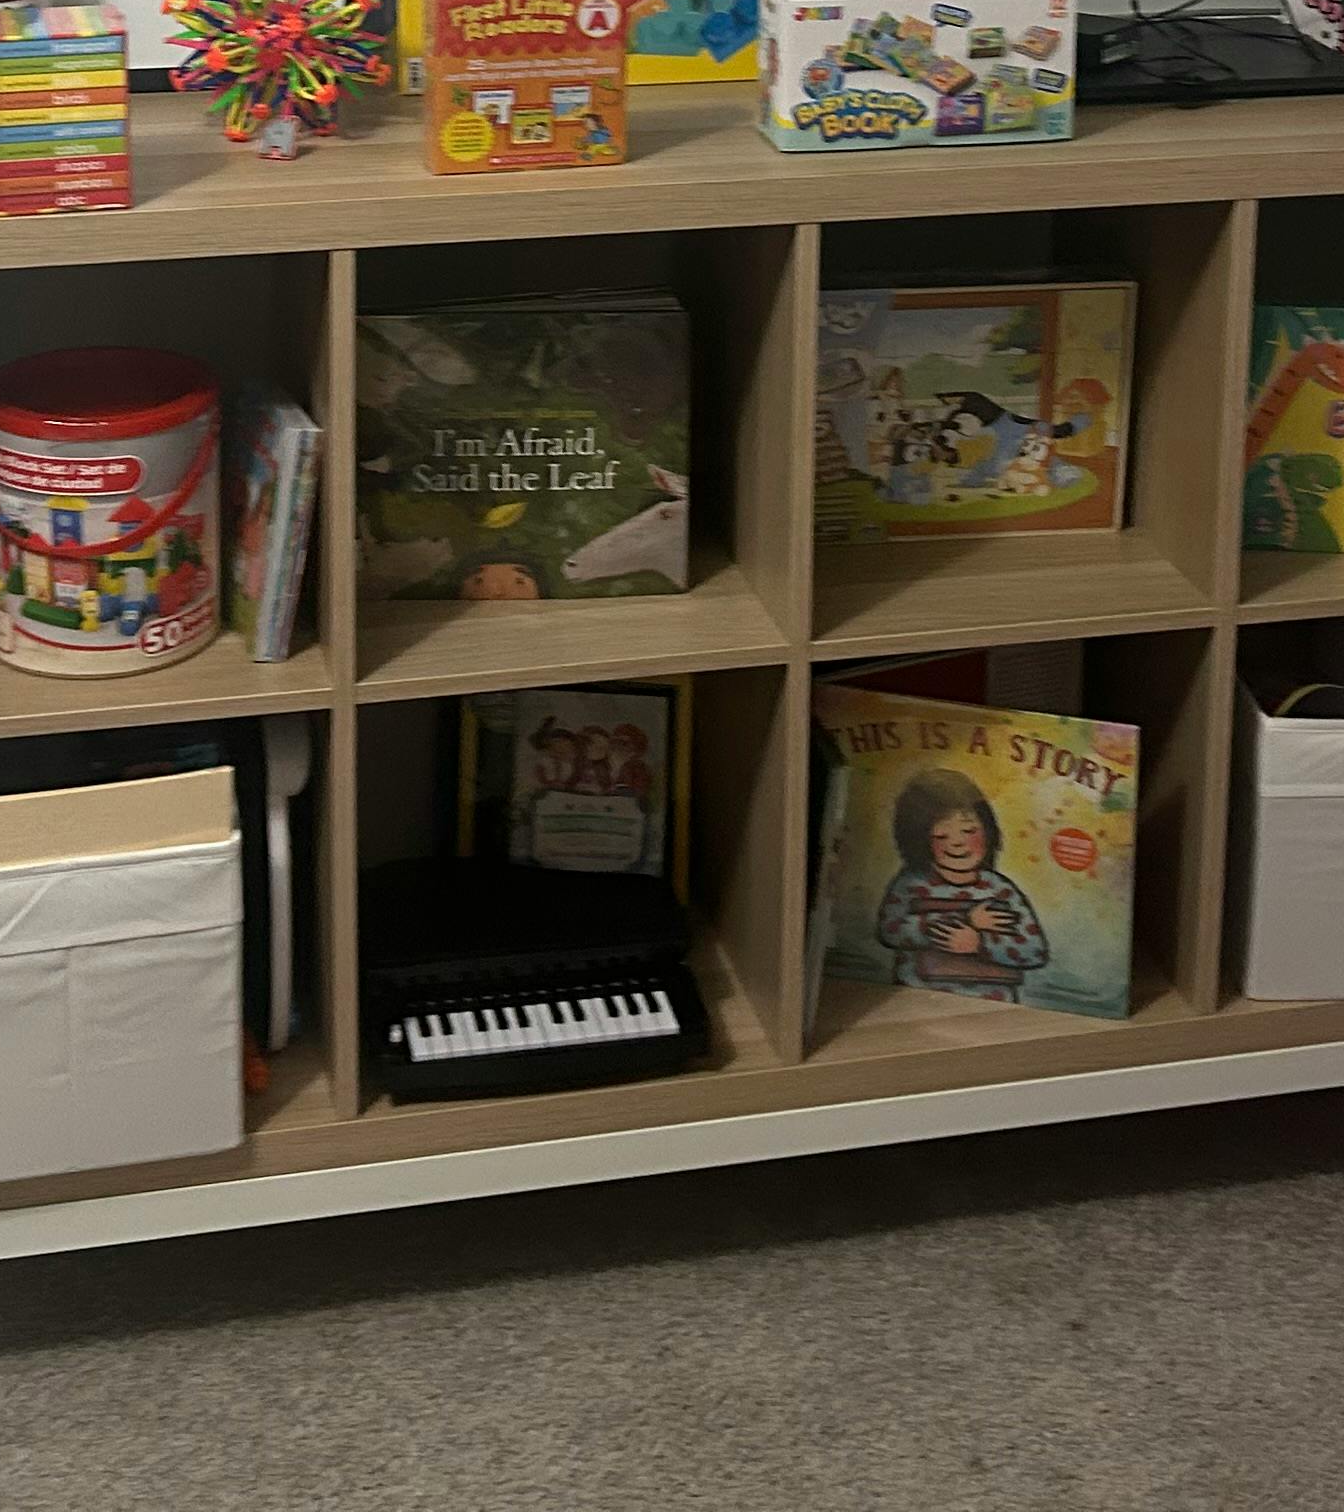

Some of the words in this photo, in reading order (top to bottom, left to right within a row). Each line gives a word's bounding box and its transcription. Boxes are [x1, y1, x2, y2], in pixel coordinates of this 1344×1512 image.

[463, 18, 568, 42] Readers
[588, 10, 610, 31] A
[822, 111, 898, 138] BOOK
[431, 427, 487, 457] I'm
[411, 462, 480, 493] Said
[488, 463, 541, 492] the
[546, 459, 621, 492] Leaf
[144, 619, 185, 655] 50
[822, 721, 903, 753] THIS
[918, 721, 951, 751] IS
[965, 725, 993, 756] A
[1008, 733, 1129, 797] STORY
